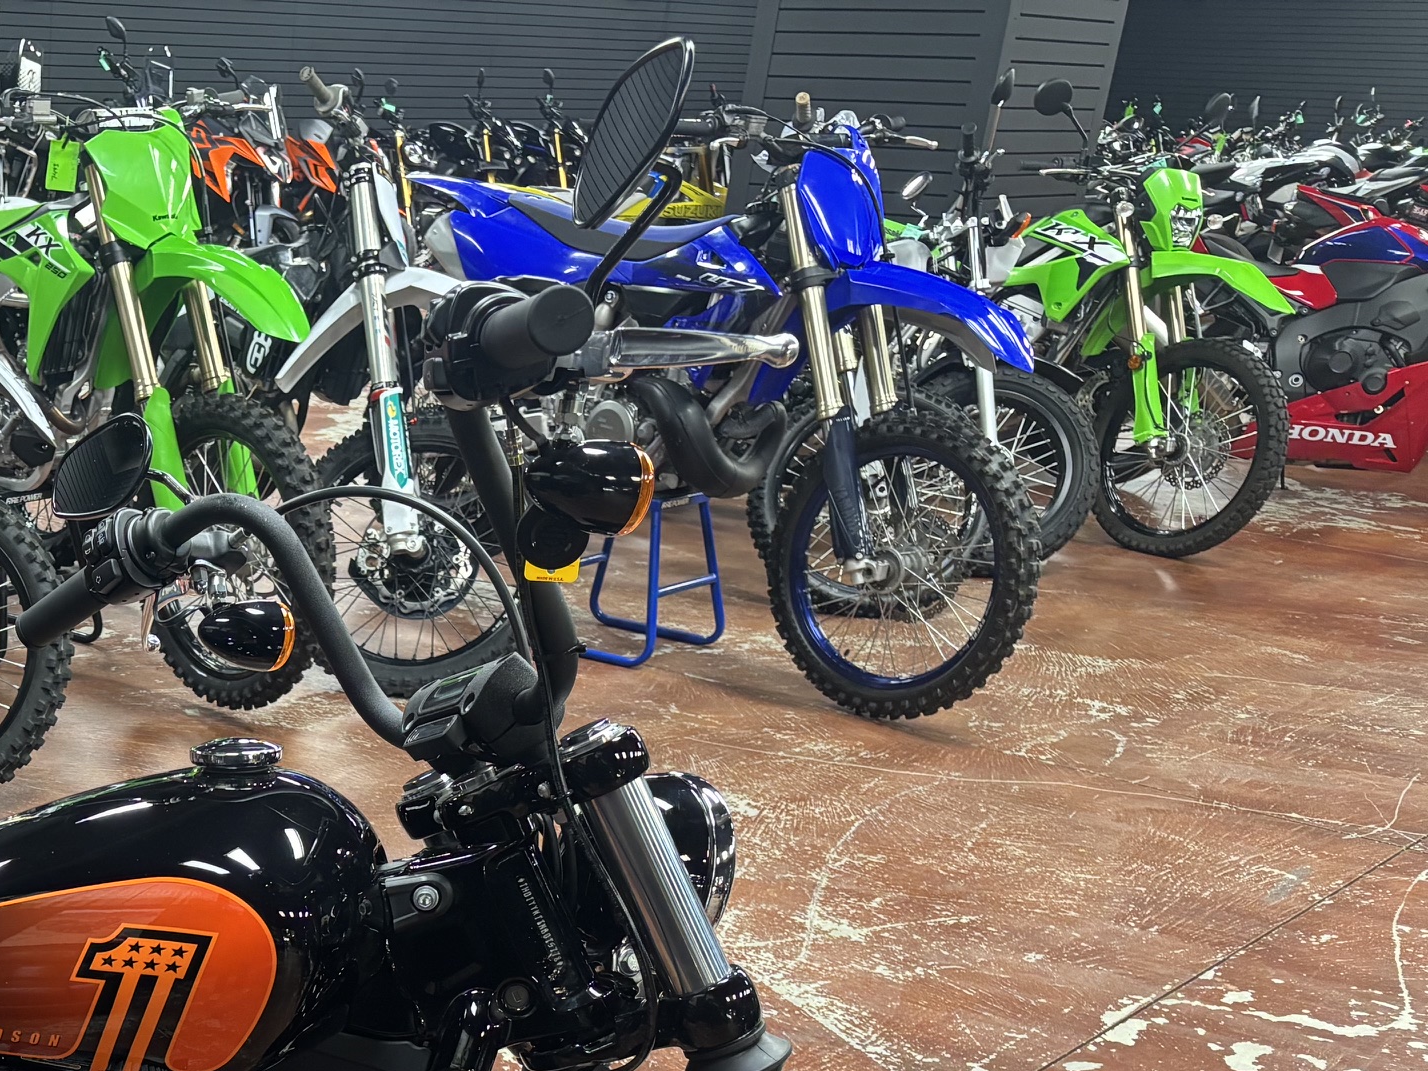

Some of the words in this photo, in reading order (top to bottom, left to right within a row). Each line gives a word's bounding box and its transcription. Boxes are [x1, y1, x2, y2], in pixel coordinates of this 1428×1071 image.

[661, 204, 723, 218] SUZUKI
[25, 225, 63, 258] KX
[44, 261, 68, 279] 250
[388, 419, 409, 479] MOTOREX
[1288, 424, 1397, 449] HONDA
